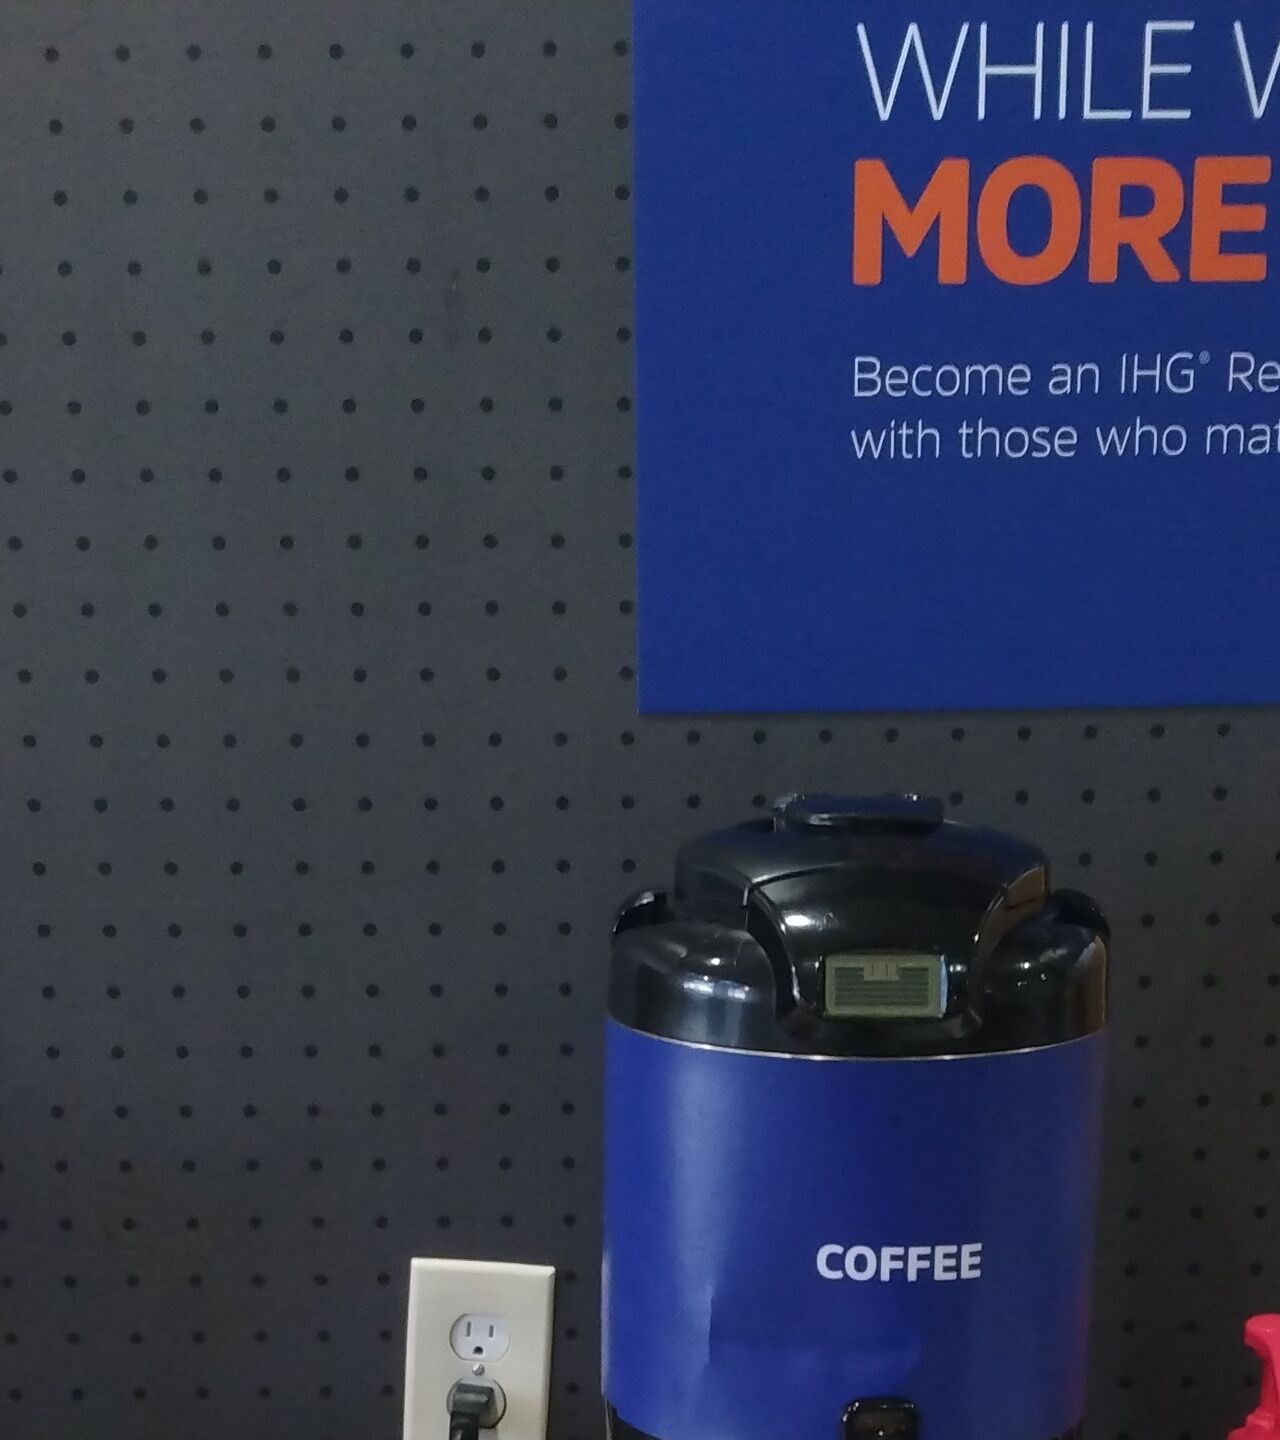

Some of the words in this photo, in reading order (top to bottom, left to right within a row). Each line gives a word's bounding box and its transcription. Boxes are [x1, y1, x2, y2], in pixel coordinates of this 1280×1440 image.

[856, 20, 1195, 122] WHILE
[852, 156, 1272, 285] MORE
[853, 355, 1032, 398] Become
[1048, 362, 1100, 395] an
[850, 418, 940, 460] with
[957, 417, 1078, 459] those
[1095, 415, 1187, 457] who
[816, 1243, 984, 1282] COFFEE
